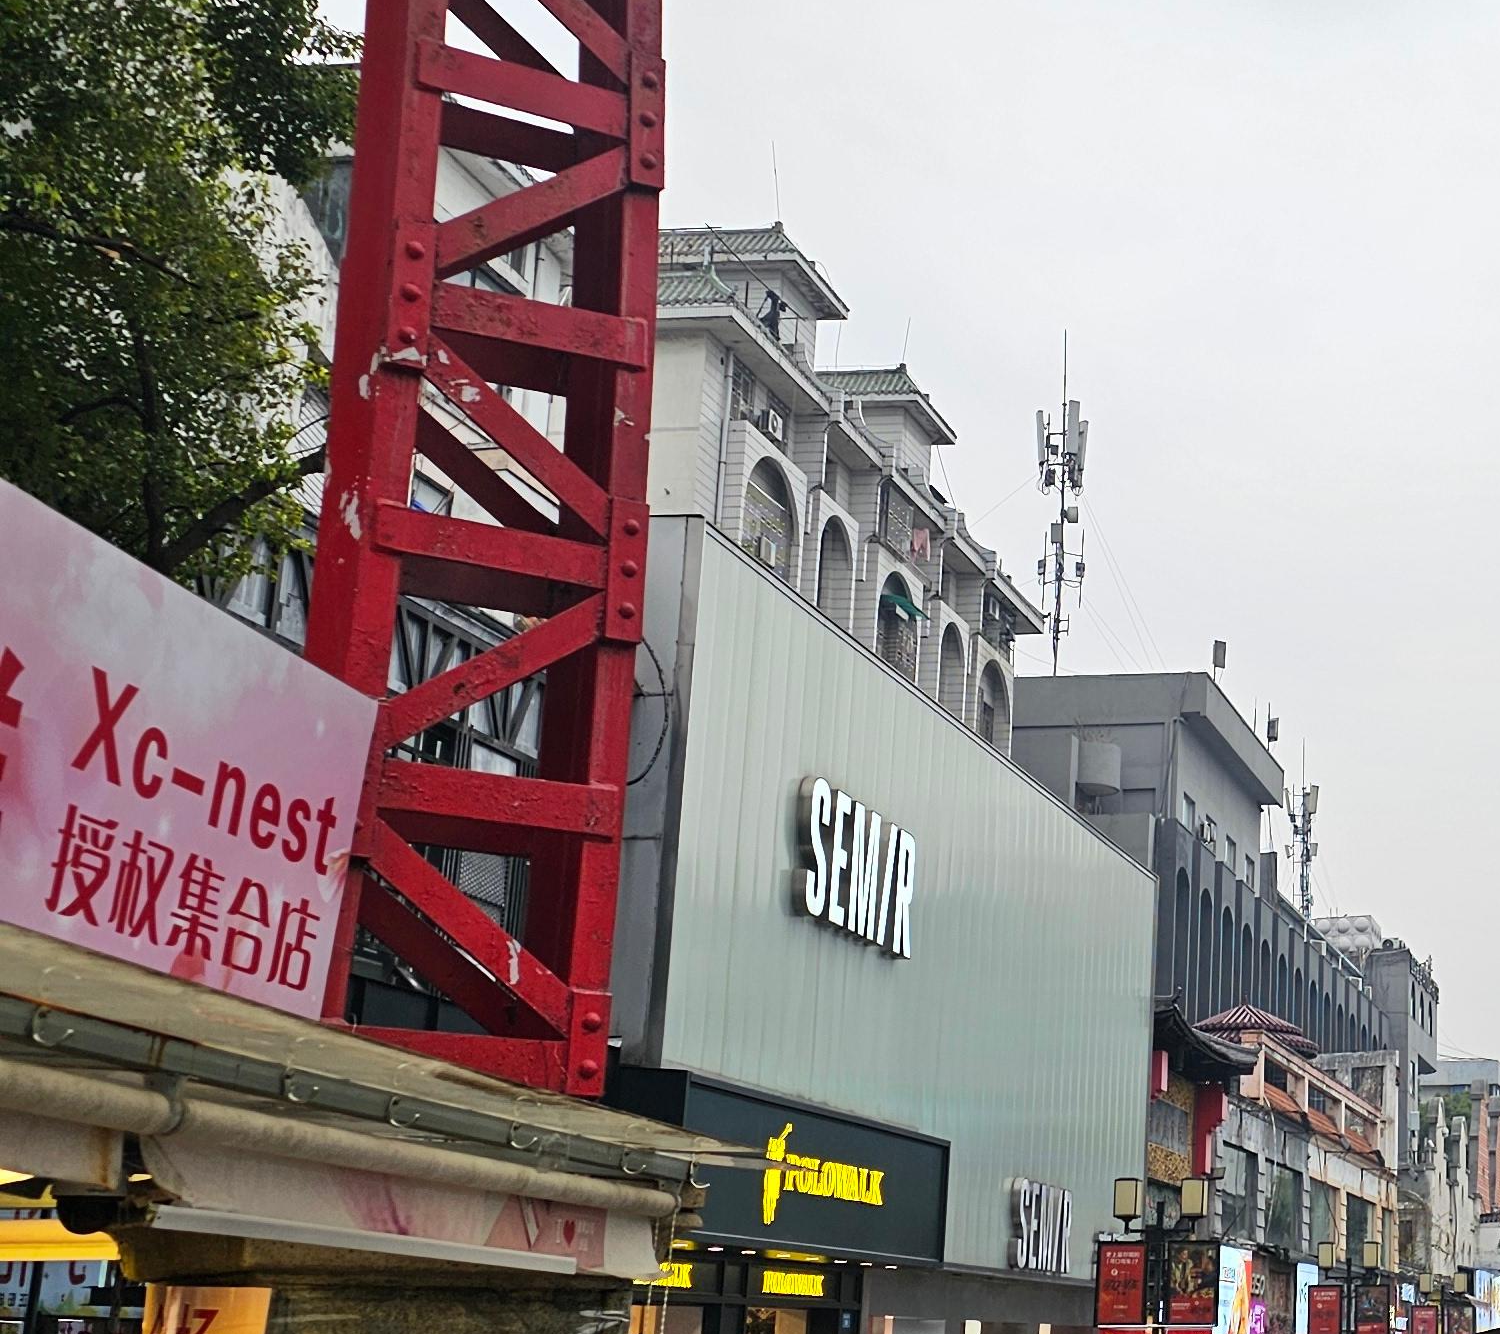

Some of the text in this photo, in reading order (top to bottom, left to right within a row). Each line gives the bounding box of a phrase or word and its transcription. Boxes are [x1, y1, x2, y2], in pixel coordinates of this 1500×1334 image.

[71, 666, 336, 875] Xc-nest
[45, 803, 321, 993] 授权集合店
[804, 777, 916, 960] SEMIR
[1017, 1177, 1073, 1274] SEMIR
